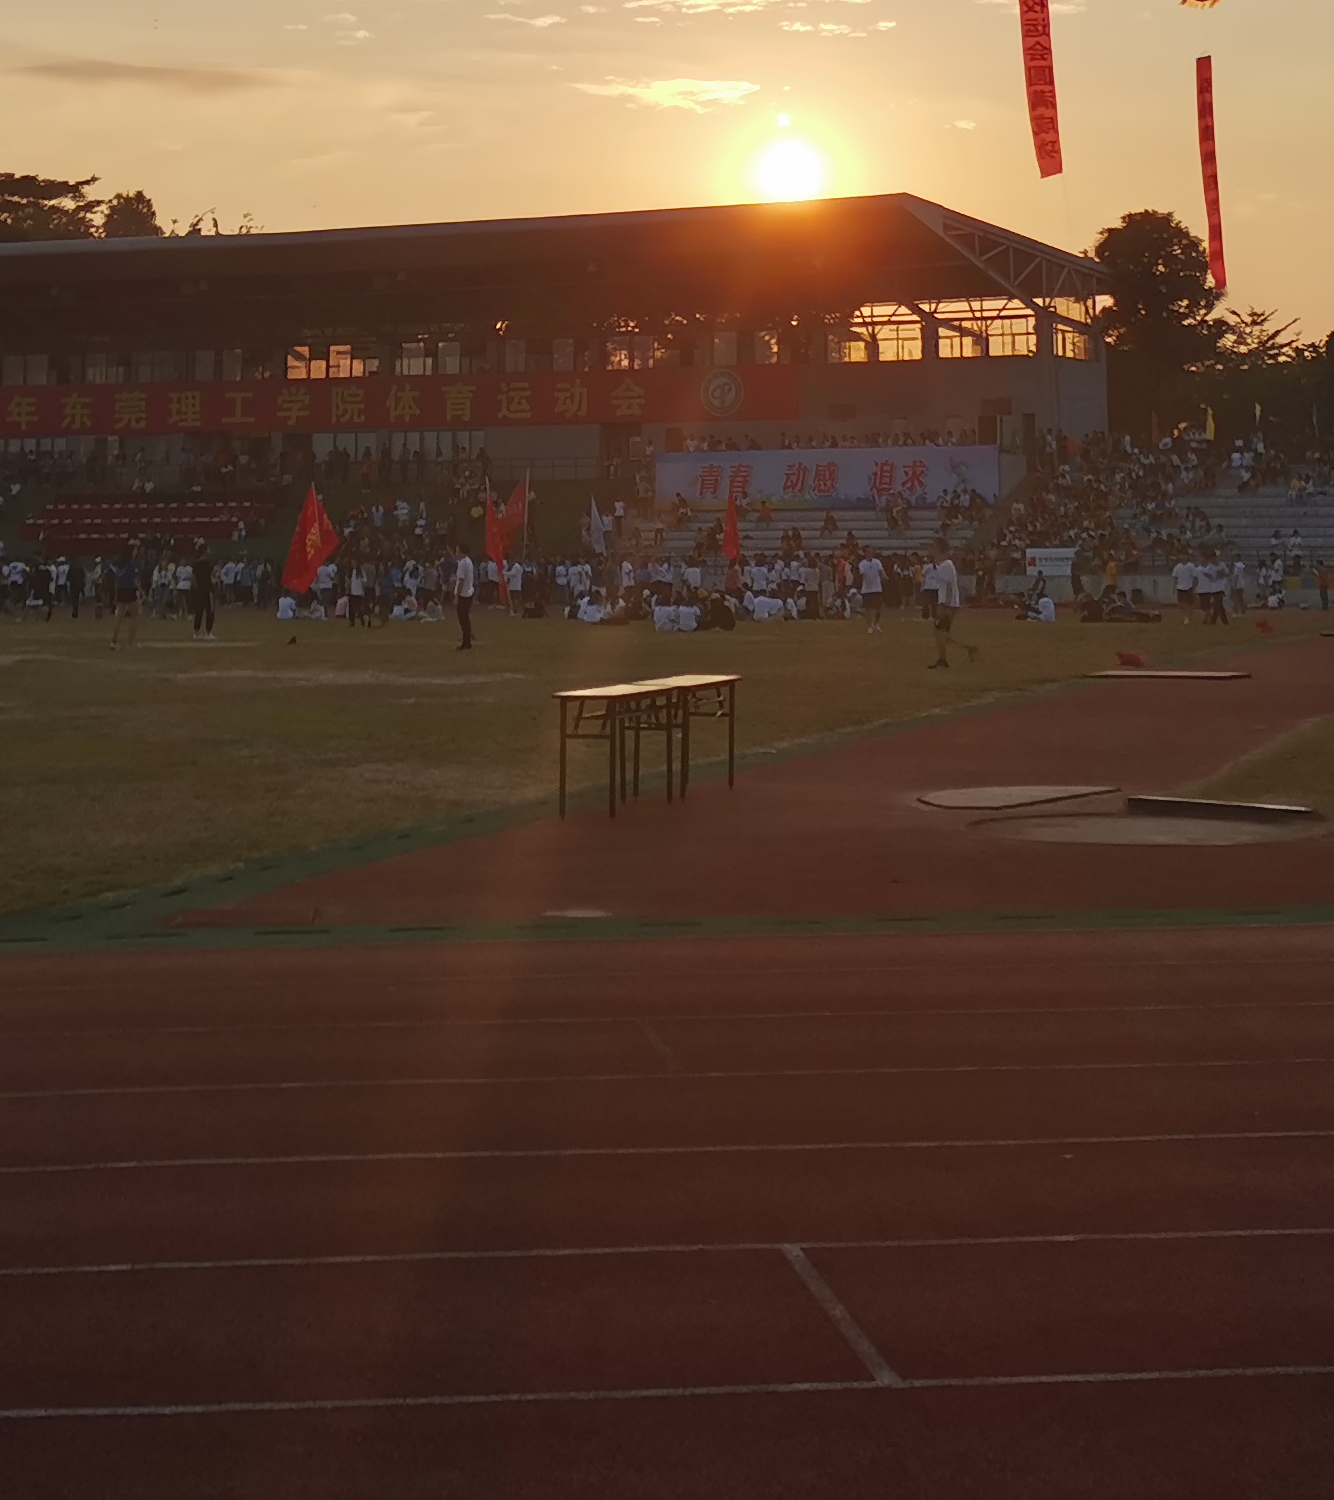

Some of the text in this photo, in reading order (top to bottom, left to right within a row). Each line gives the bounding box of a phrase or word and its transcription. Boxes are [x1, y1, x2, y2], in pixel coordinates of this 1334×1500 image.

[698, 459, 929, 499] 青春 动感 追求
